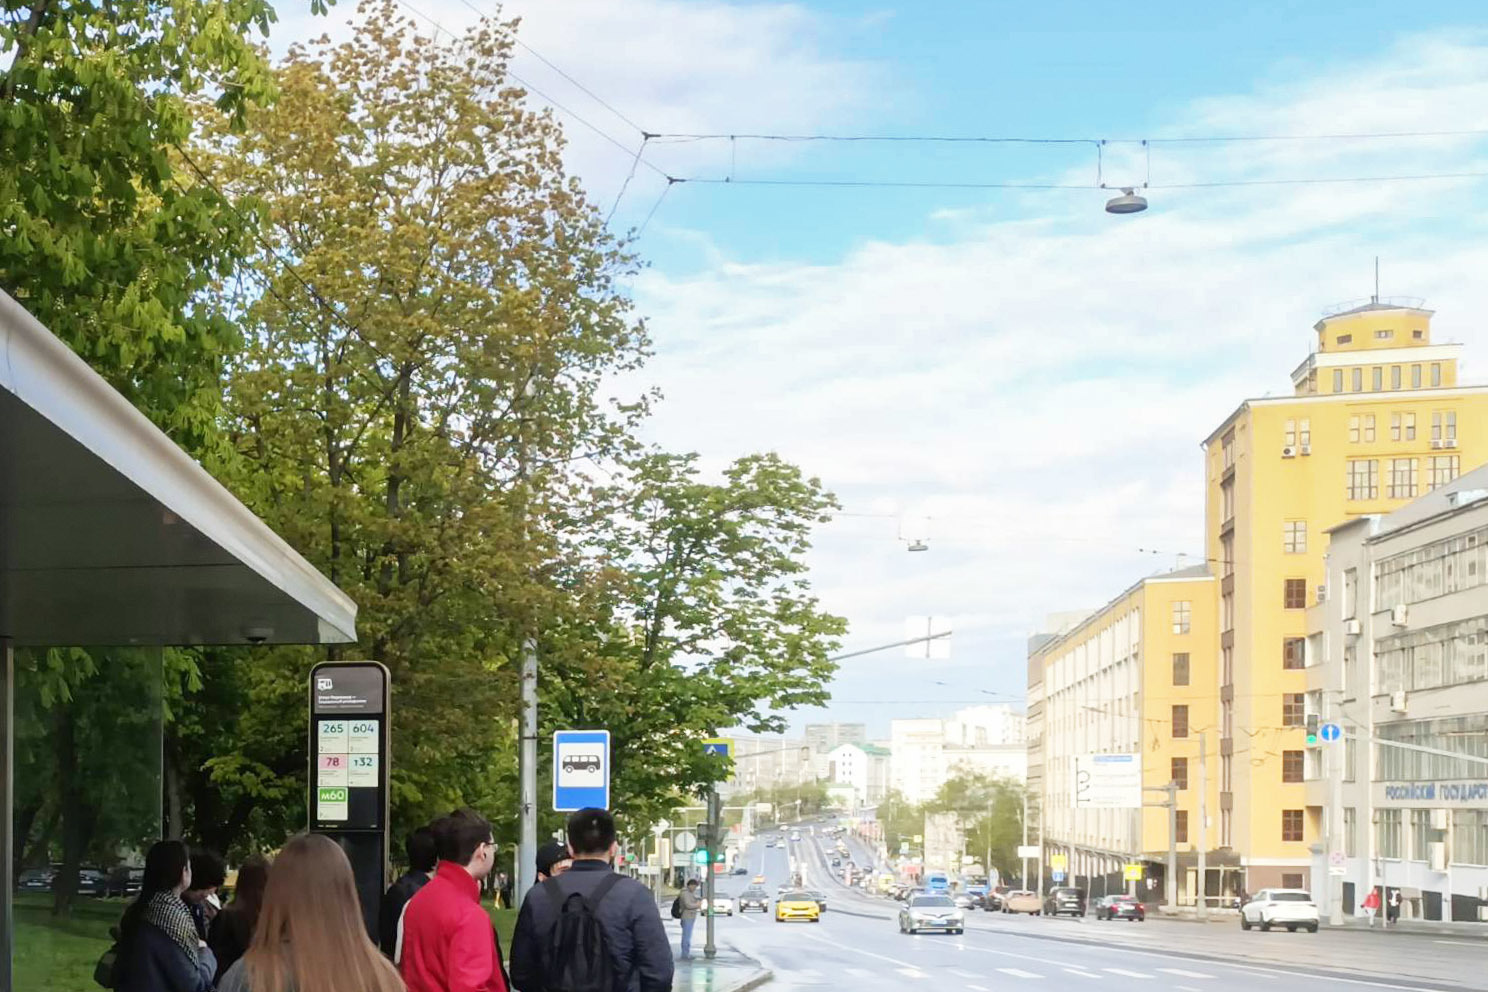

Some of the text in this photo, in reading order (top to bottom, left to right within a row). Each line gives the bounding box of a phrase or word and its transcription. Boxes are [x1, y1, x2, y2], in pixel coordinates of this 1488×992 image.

[323, 724, 343, 733] 265
[353, 724, 374, 733] 604
[326, 757, 340, 767] 78
